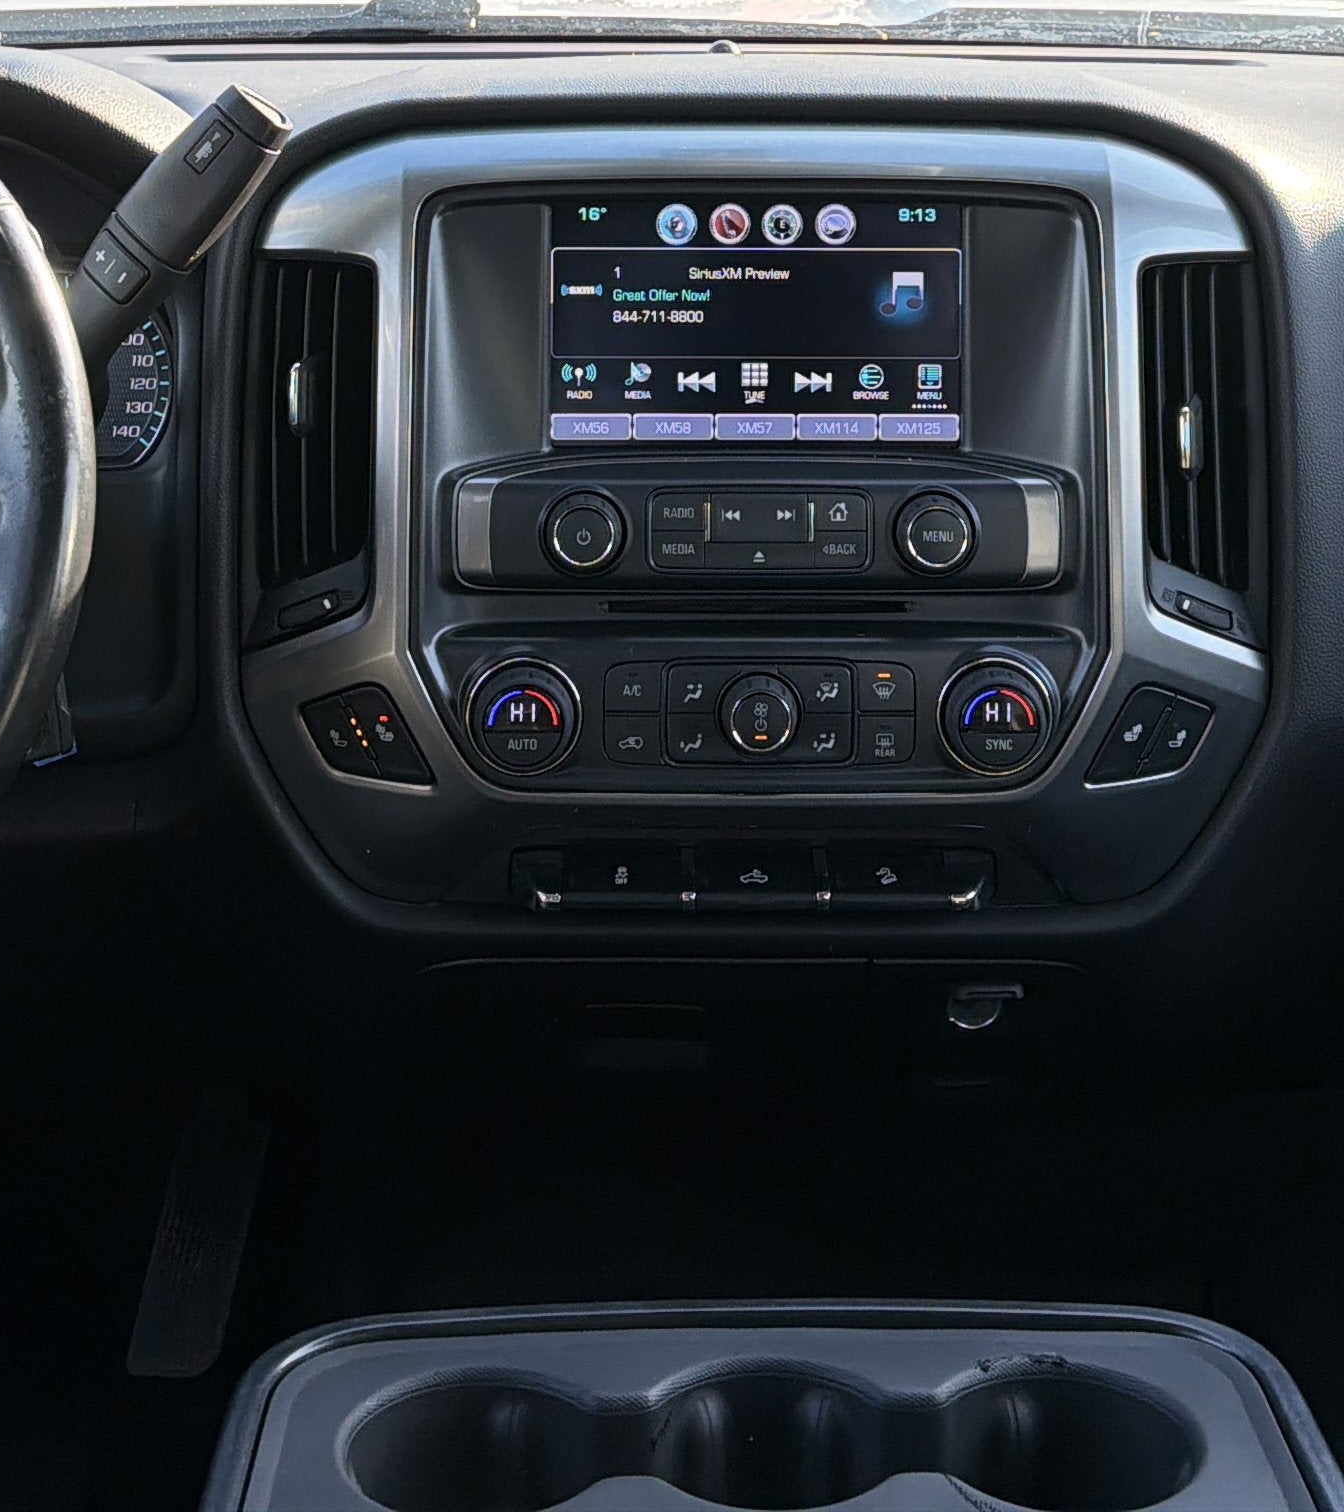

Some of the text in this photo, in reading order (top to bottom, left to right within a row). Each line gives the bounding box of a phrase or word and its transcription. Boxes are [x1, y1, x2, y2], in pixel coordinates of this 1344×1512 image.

[898, 208, 937, 222] 9:13
[614, 266, 790, 280] 1 SiriusXM Preview
[613, 289, 711, 302] Great Offer Now!
[613, 311, 704, 323] 844-711-8800
[131, 354, 154, 367] 110
[129, 377, 156, 390] 120
[567, 390, 943, 400] RADIO MEDIA TUNE BROWSE MENU
[125, 401, 153, 414] 130
[112, 425, 140, 438] 140
[573, 422, 941, 435] XM56 XM58 XM57 XM114 XM125
[663, 507, 954, 543] RADIO MENU
[662, 543, 856, 555] MEDIA BACK
[622, 685, 642, 697] A/C
[985, 702, 1012, 723] HI
[507, 738, 1013, 751] AUTO SYNC
[875, 748, 896, 758] REAR
